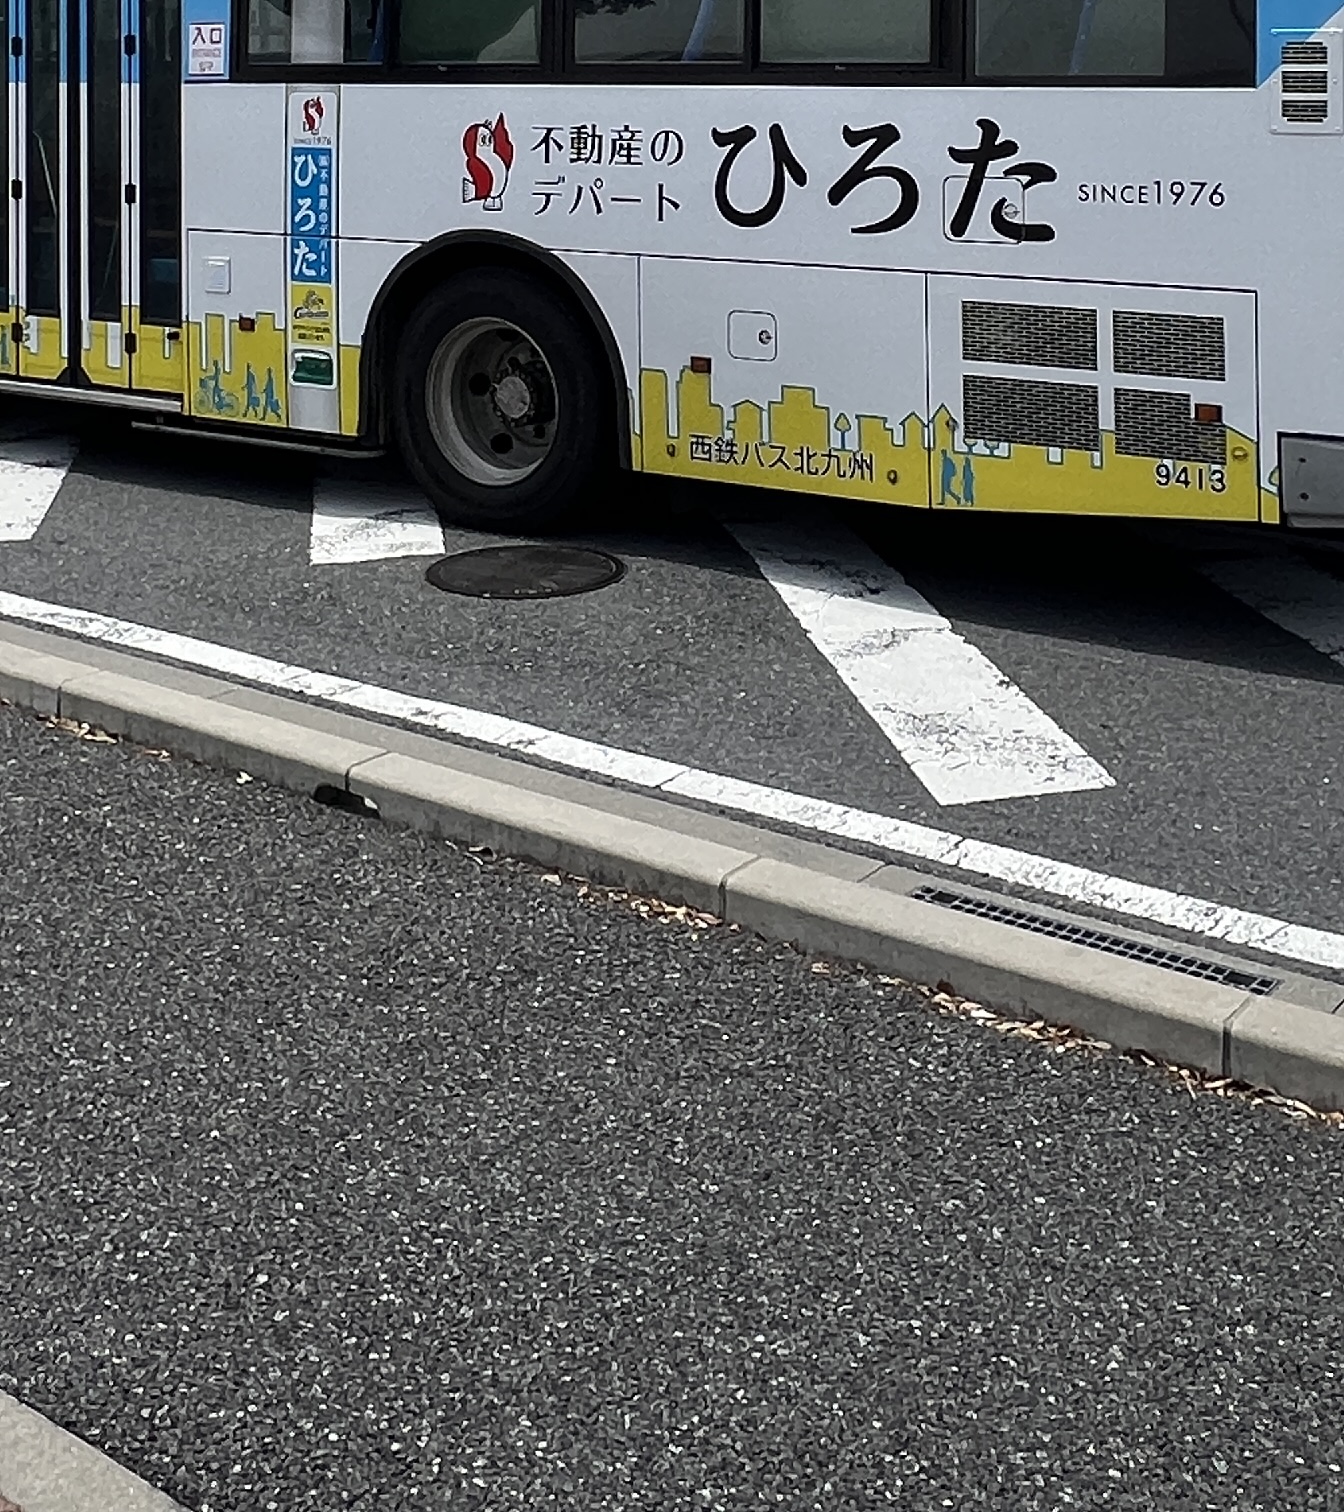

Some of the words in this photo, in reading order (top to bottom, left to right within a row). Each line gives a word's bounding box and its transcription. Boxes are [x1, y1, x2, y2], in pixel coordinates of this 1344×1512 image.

[192, 27, 222, 45] 入口
[531, 124, 685, 168] 不動産の
[531, 177, 682, 222] デパート
[711, 118, 1057, 243] ひろた
[294, 153, 318, 276] ひろた
[689, 433, 874, 483] 西鉄バス北九州
[1156, 462, 1227, 493] 9413
